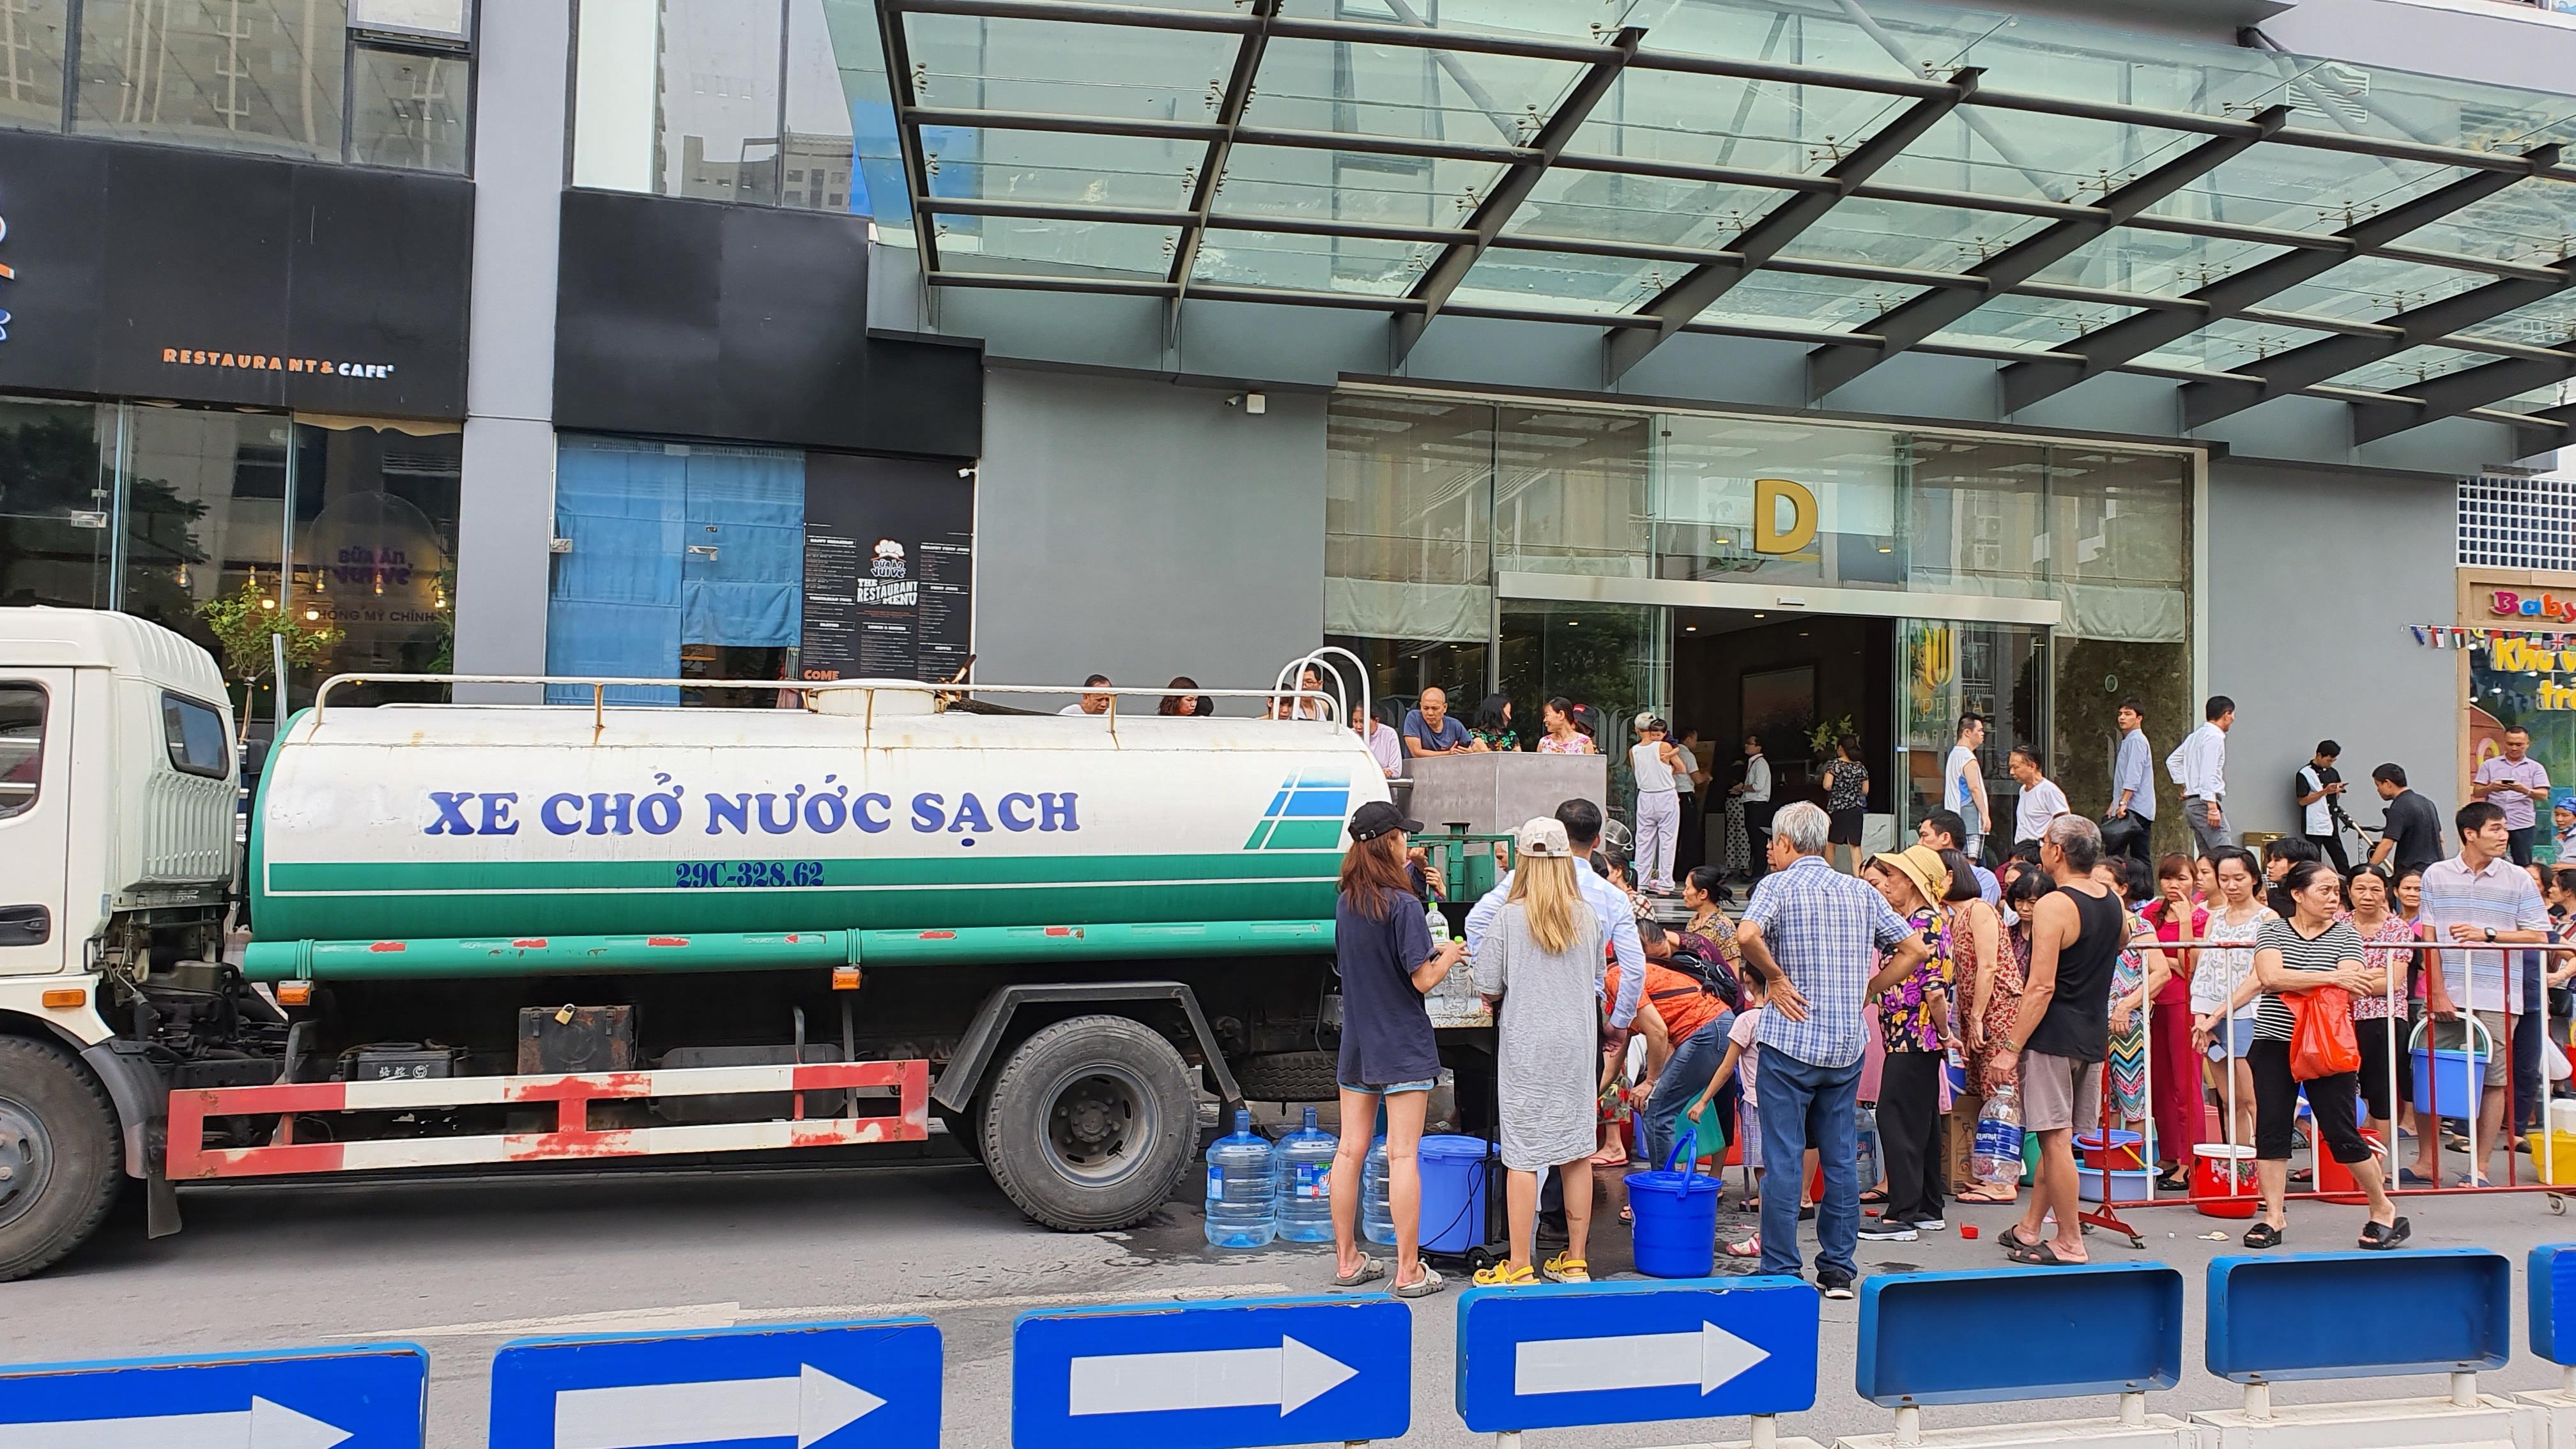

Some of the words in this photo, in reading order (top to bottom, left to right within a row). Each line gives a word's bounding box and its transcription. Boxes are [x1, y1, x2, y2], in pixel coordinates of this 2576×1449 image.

[1754, 479, 1819, 555] D
[857, 578, 878, 587] THE
[857, 581, 918, 602] RESTAURANT
[882, 592, 917, 606] MENU
[2492, 638, 2555, 672] Khu
[804, 670, 839, 680] COME
[424, 792, 519, 835] XE
[540, 772, 684, 835] CHỞ
[705, 774, 891, 834] NƯỚC
[911, 792, 1080, 847] SẠCH
[676, 861, 825, 887] 29C-328.62
